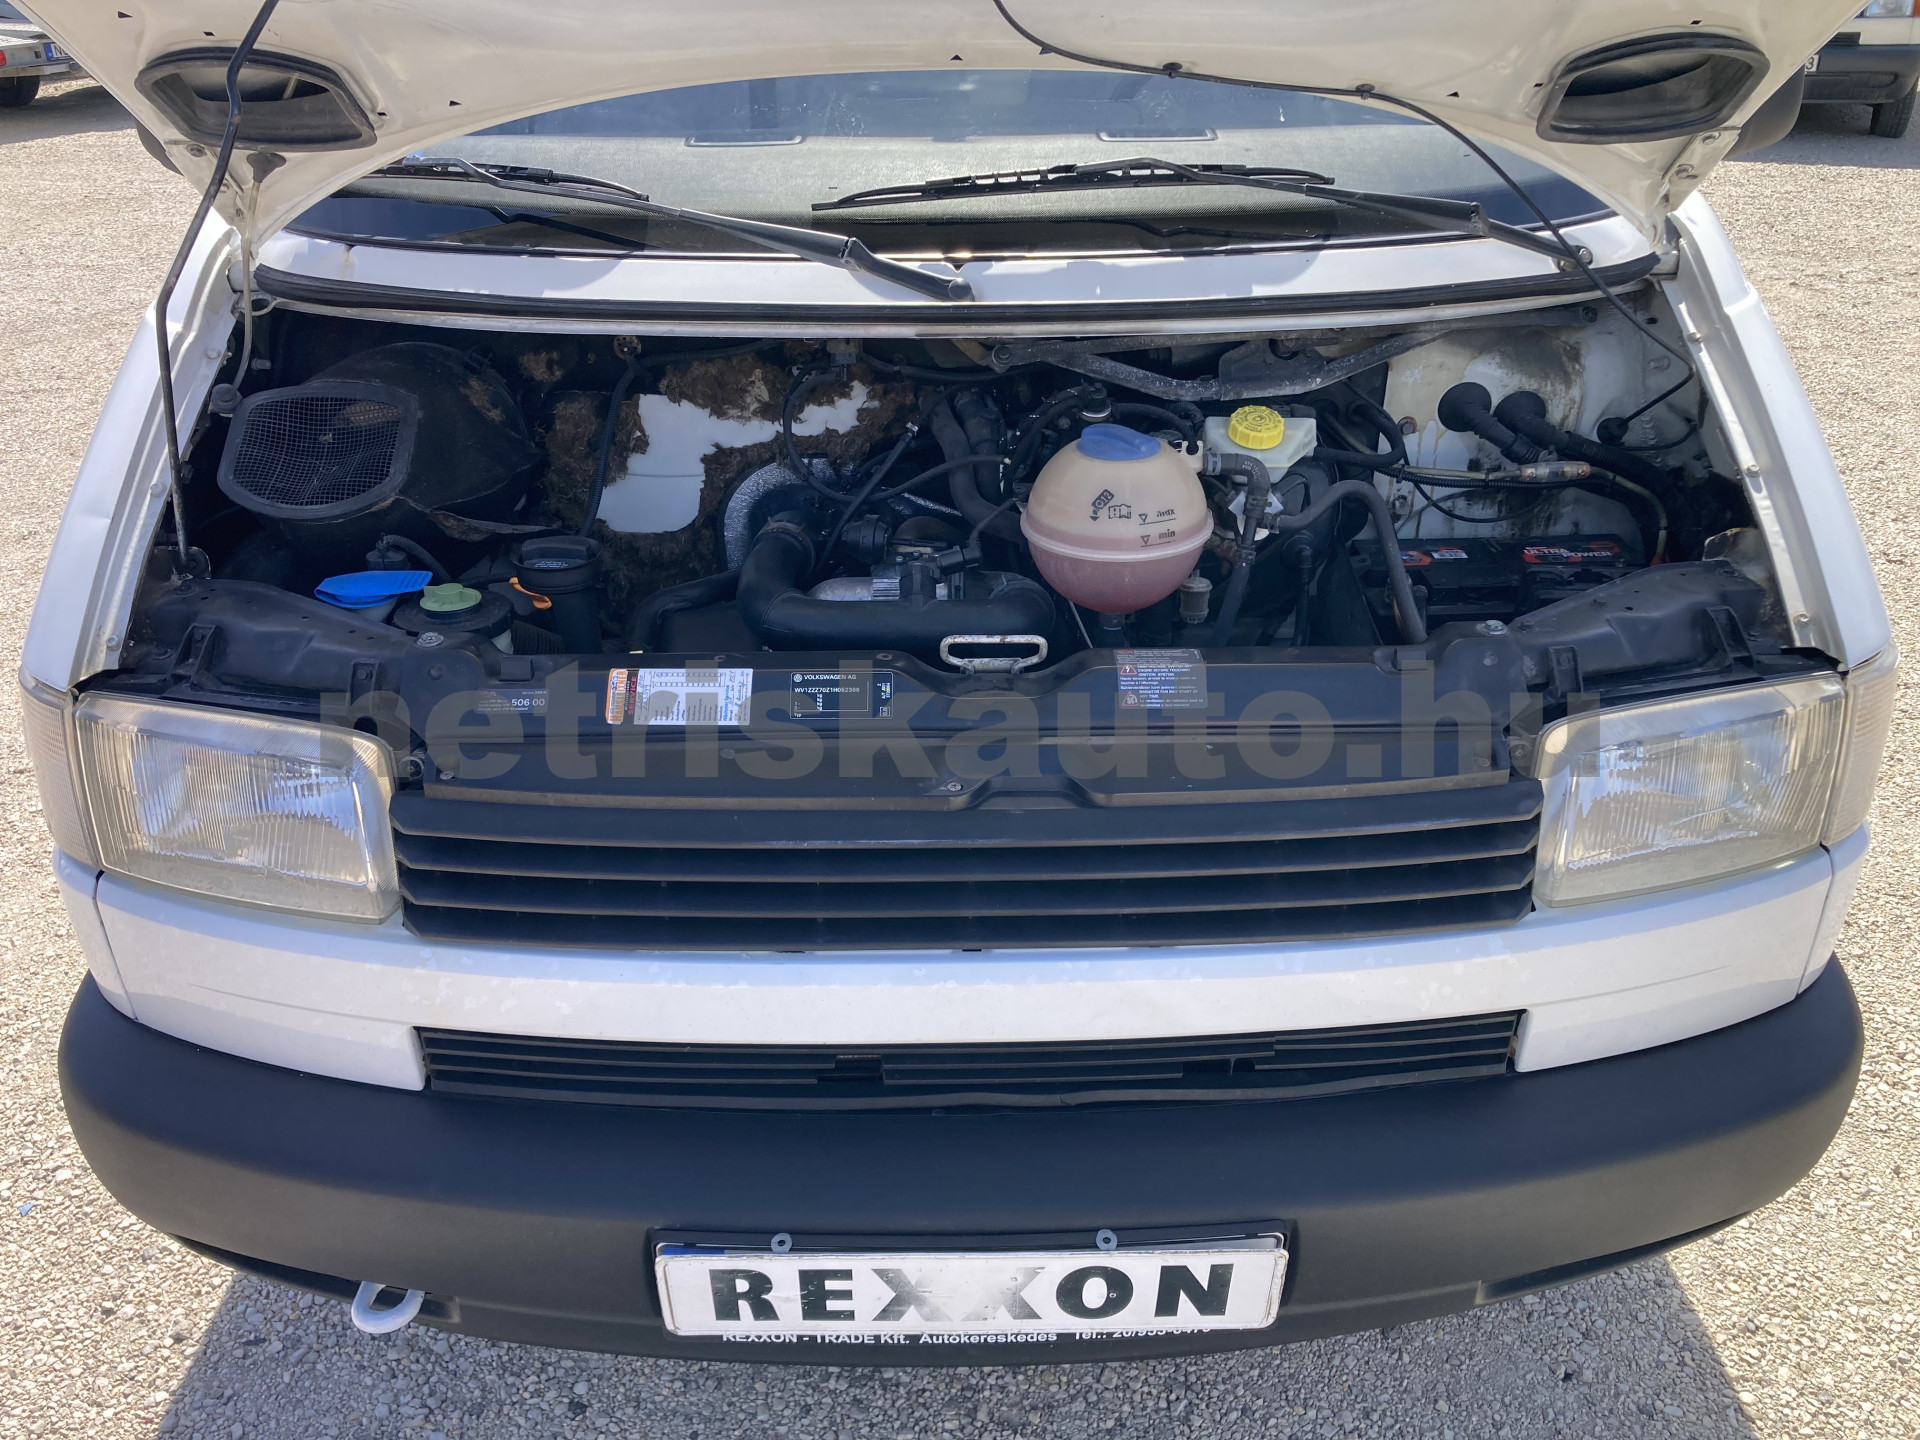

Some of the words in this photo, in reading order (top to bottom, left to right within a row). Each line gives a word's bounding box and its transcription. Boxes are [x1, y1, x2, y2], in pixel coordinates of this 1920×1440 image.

[1158, 529, 1176, 540] min
[511, 698, 530, 707] 506
[532, 698, 545, 707] 00
[628, 676, 637, 716] SERVICE
[708, 1263, 1235, 1322] REXXON
[722, 1331, 798, 1343] REXXON
[816, 1333, 875, 1344] TRADE
[880, 1333, 910, 1344] Kft.
